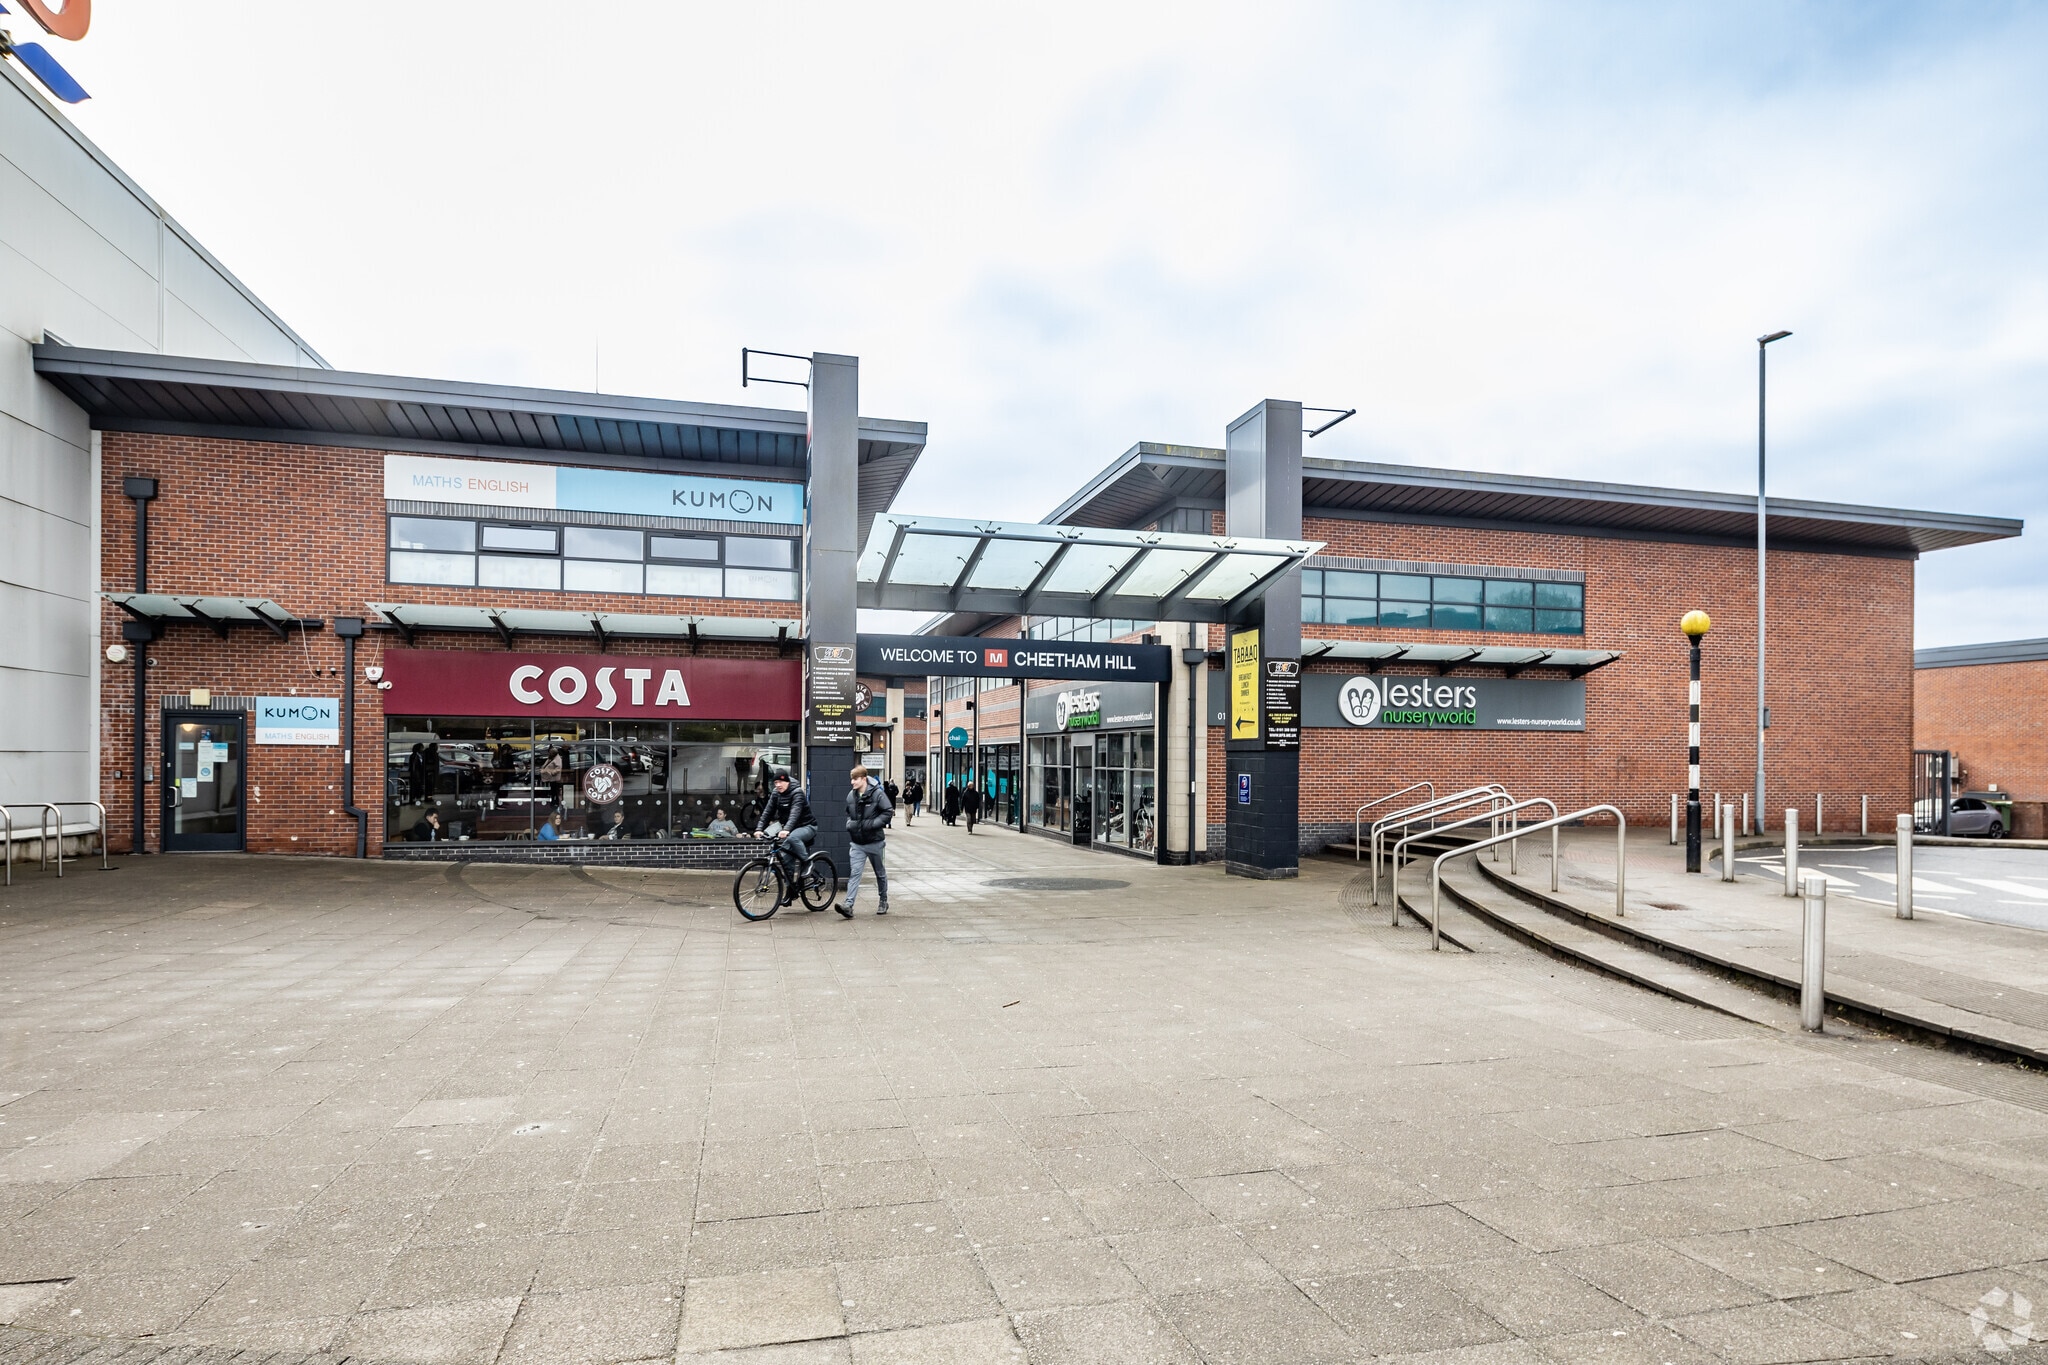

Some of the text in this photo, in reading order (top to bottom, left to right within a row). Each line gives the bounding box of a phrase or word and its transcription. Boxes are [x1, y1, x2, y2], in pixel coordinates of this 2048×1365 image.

[412, 474, 529, 494] MATHS ENGLISH
[672, 489, 773, 514] KUMON
[880, 648, 1137, 670] WELCOME TO M CHEETHAM HILL
[1233, 644, 1258, 664] TABAAQ
[509, 664, 691, 711] COSTA
[1381, 677, 1477, 708] lesters
[1068, 689, 1101, 714] lesters
[265, 705, 330, 720] KUMON
[1068, 711, 1100, 730] nurseryworld
[1382, 708, 1476, 727] nurseryworld
[1496, 717, 1582, 727] www.lesters-nurseryworld.co.uk
[589, 767, 615, 778] COSTA
[587, 787, 618, 801] COFFEE
